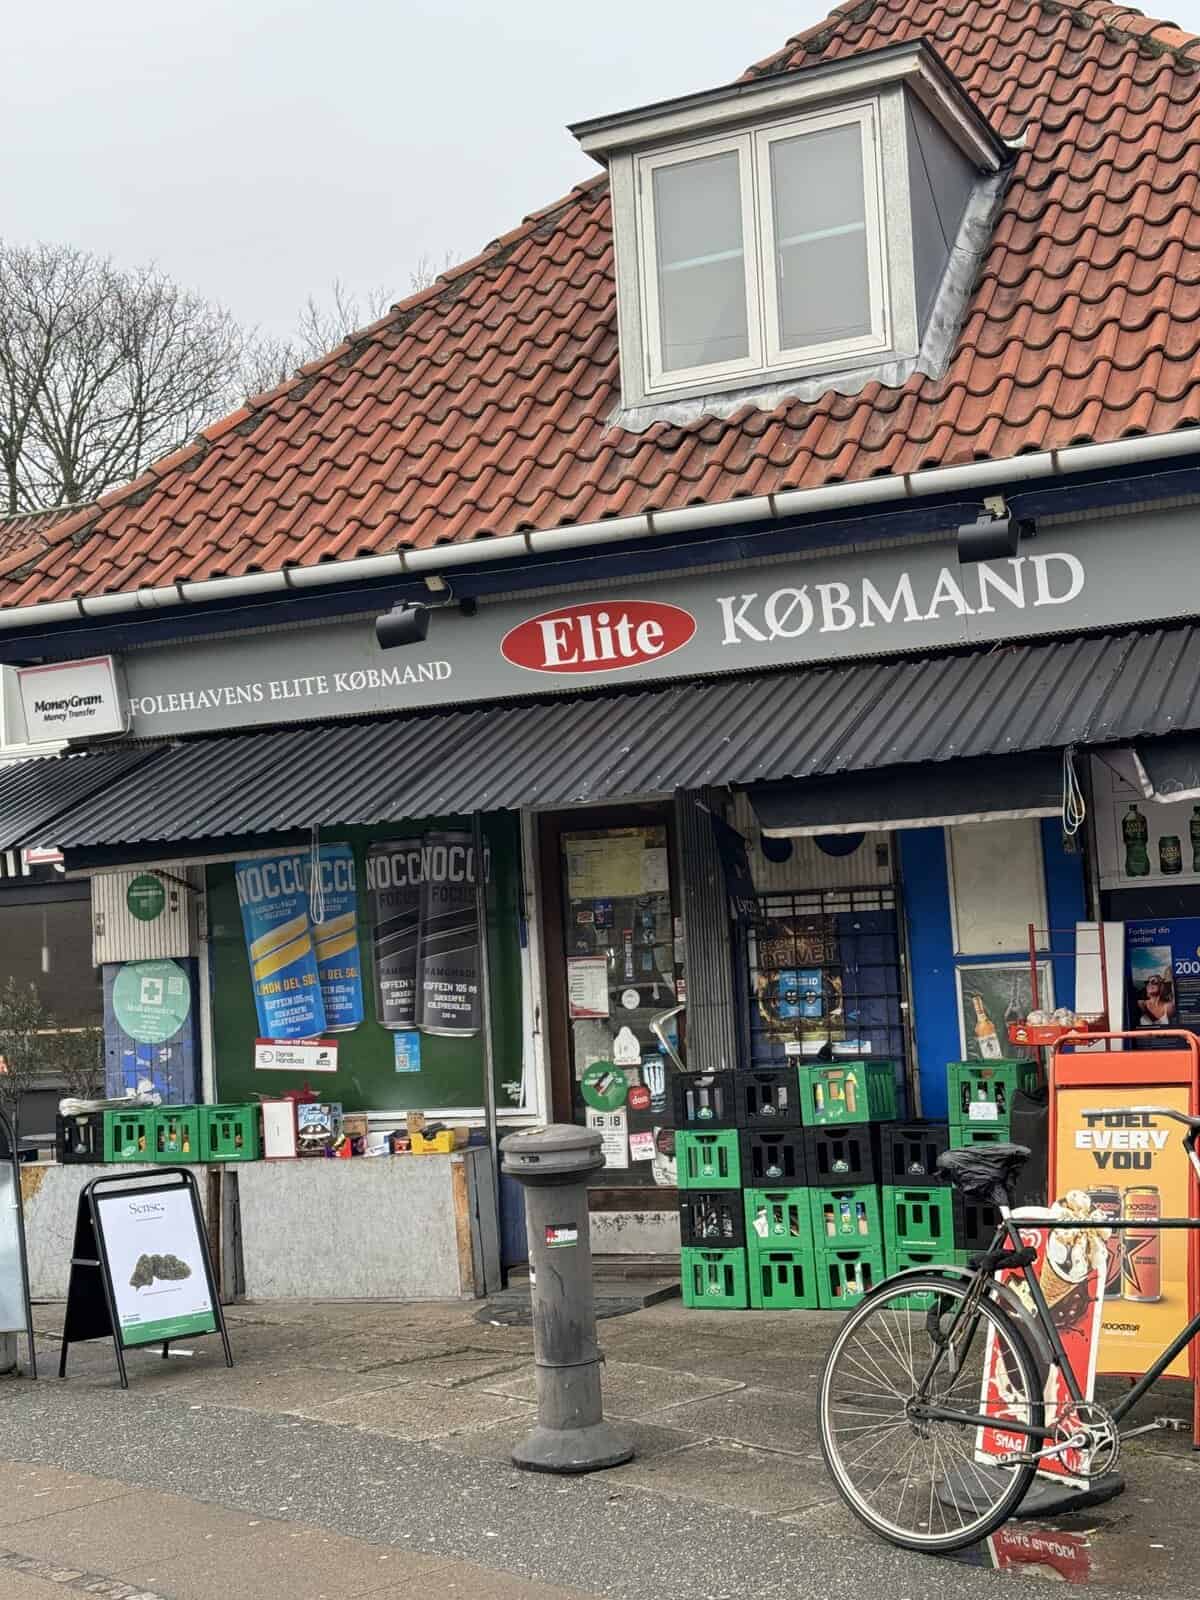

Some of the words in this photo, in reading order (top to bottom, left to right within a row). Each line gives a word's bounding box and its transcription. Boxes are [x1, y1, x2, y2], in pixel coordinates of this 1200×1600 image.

[536, 612, 665, 667] Elite
[716, 552, 1085, 646] KØBMAND
[129, 682, 264, 716] FOLEHAVENS
[269, 675, 329, 701] ELITE
[333, 660, 452, 693] KØBMAND
[34, 694, 102, 713] MoneyGram
[43, 713, 66, 722] Money
[68, 707, 96, 719] Transfer
[1075, 1130, 1169, 1149] EVERY
[1092, 1151, 1152, 1169] YOU
[994, 1432, 1023, 1452] SMAG
